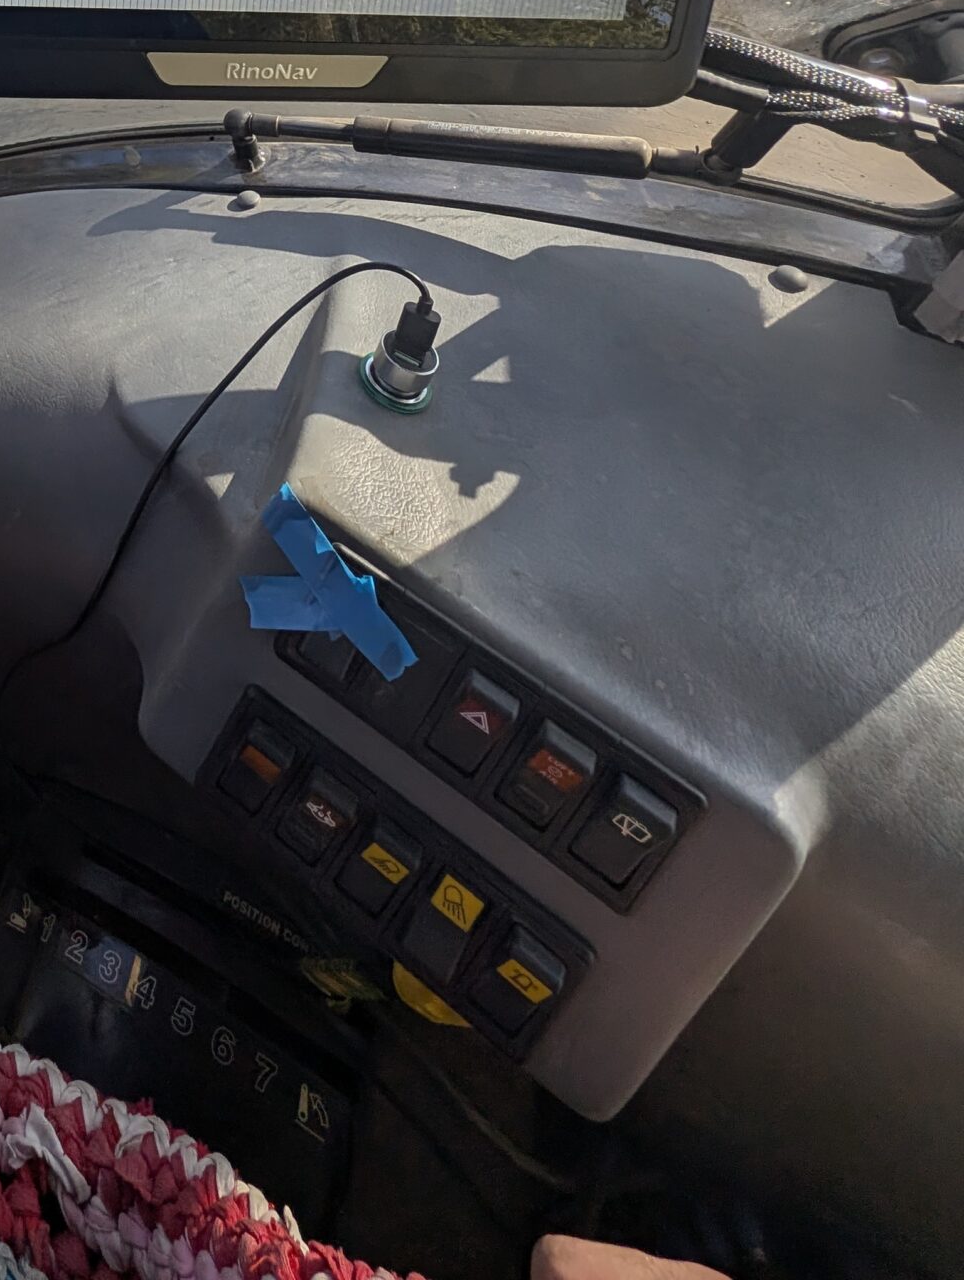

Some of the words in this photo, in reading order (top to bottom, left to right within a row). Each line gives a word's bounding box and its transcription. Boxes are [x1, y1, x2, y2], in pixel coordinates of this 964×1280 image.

[226, 61, 319, 81] RinoNav
[223, 889, 282, 937] POSITION
[39, 914, 56, 943] 1
[64, 929, 89, 965] 2
[98, 950, 122, 984] 3
[135, 975, 157, 1009] 4
[170, 997, 197, 1037] 5
[210, 1025, 237, 1067] 6
[254, 1051, 278, 1093] 7
